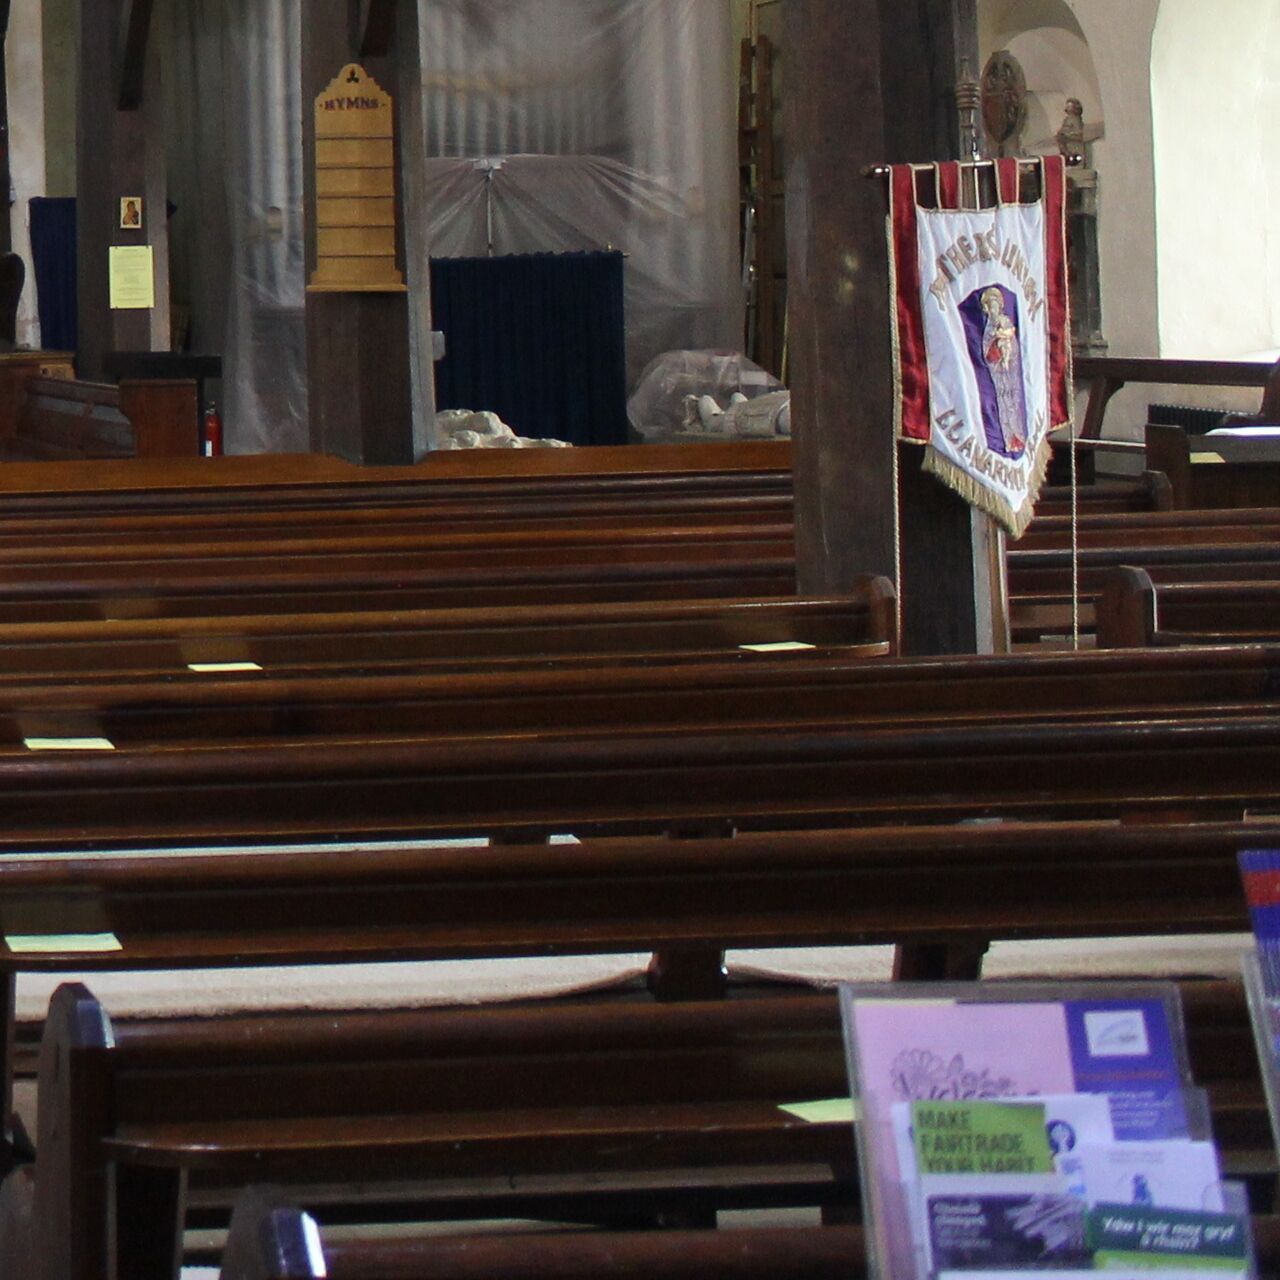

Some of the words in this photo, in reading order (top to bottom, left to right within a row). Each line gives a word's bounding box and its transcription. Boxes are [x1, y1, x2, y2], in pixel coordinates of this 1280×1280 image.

[324, 96, 379, 111] HYMNS
[917, 1108, 971, 1130] MAKE
[918, 1132, 1024, 1154] FAIRTRADE
[979, 1156, 1037, 1174] HABIT
